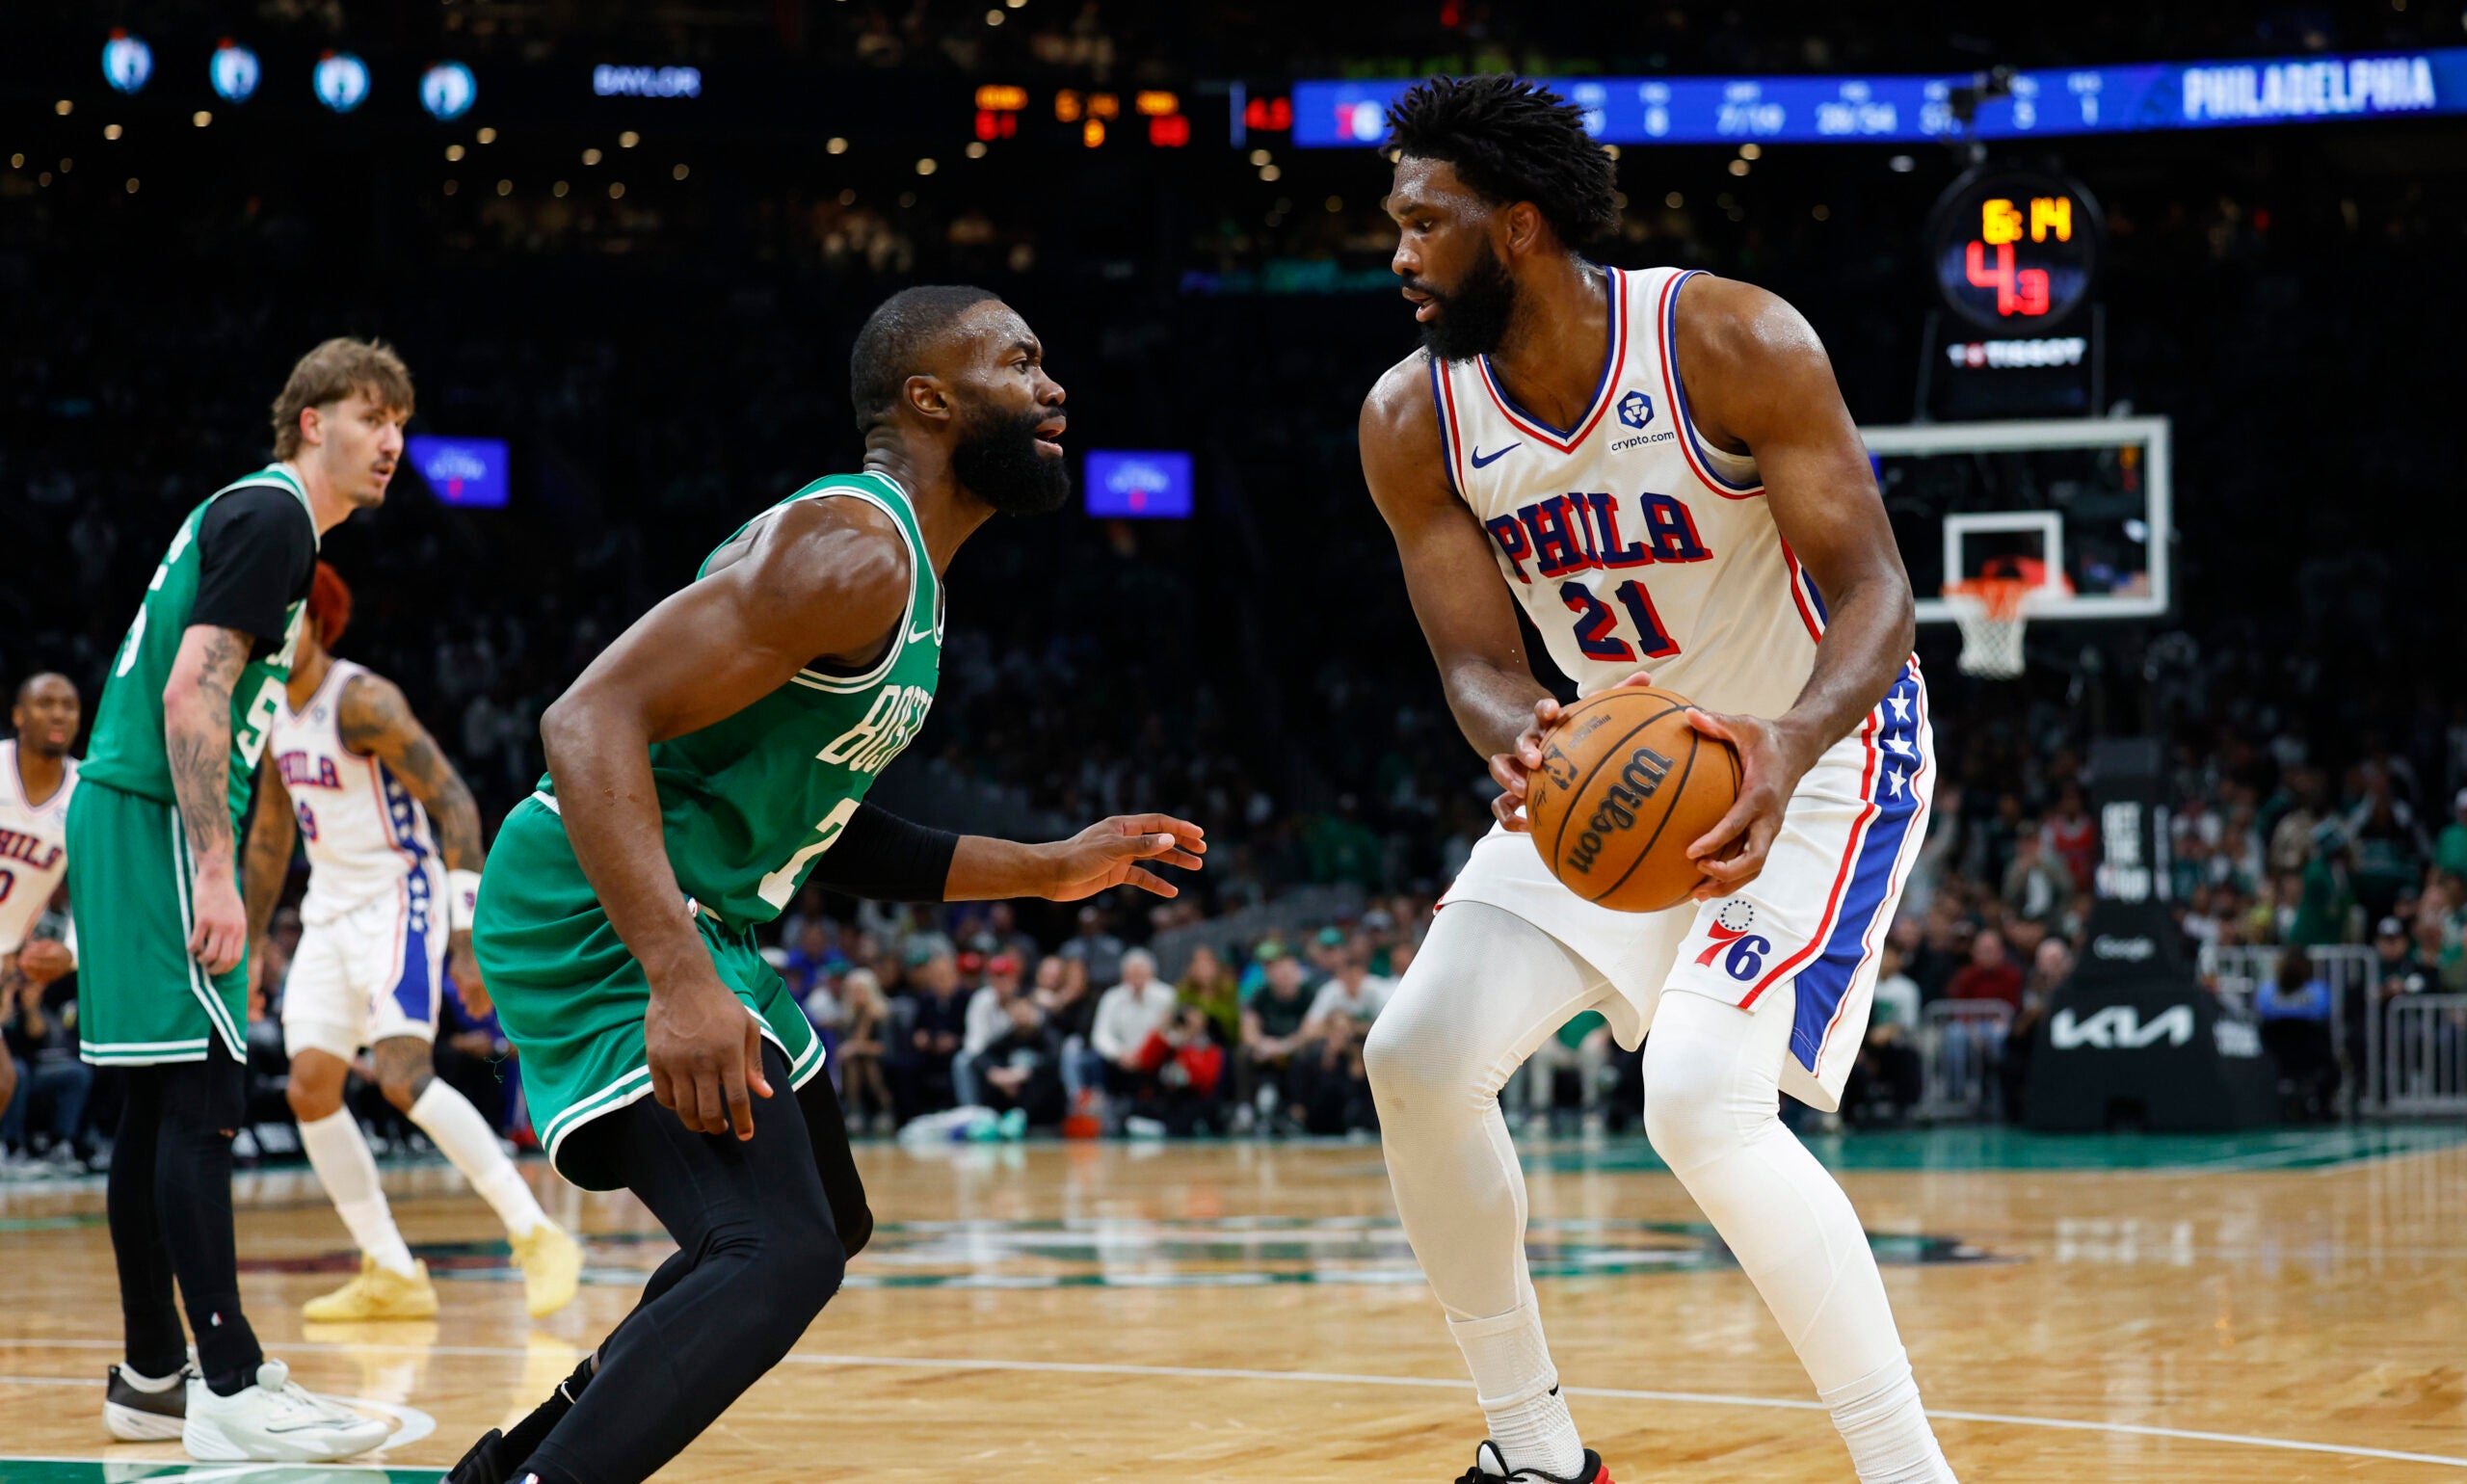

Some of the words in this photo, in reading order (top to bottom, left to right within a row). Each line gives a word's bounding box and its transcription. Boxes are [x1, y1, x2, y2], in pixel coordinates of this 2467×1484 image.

[2183, 56, 2436, 120] PHILADELPHIA
[1611, 431, 1675, 451] crypto.com
[1485, 491, 1713, 585] PHILA
[1559, 579, 1682, 663] 21
[1566, 747, 1678, 875] Wilson
[757, 797, 861, 912] 7
[1694, 918, 1771, 982] 76
[2093, 934, 2156, 963] Google
[2050, 1004, 2195, 1050] KIA
